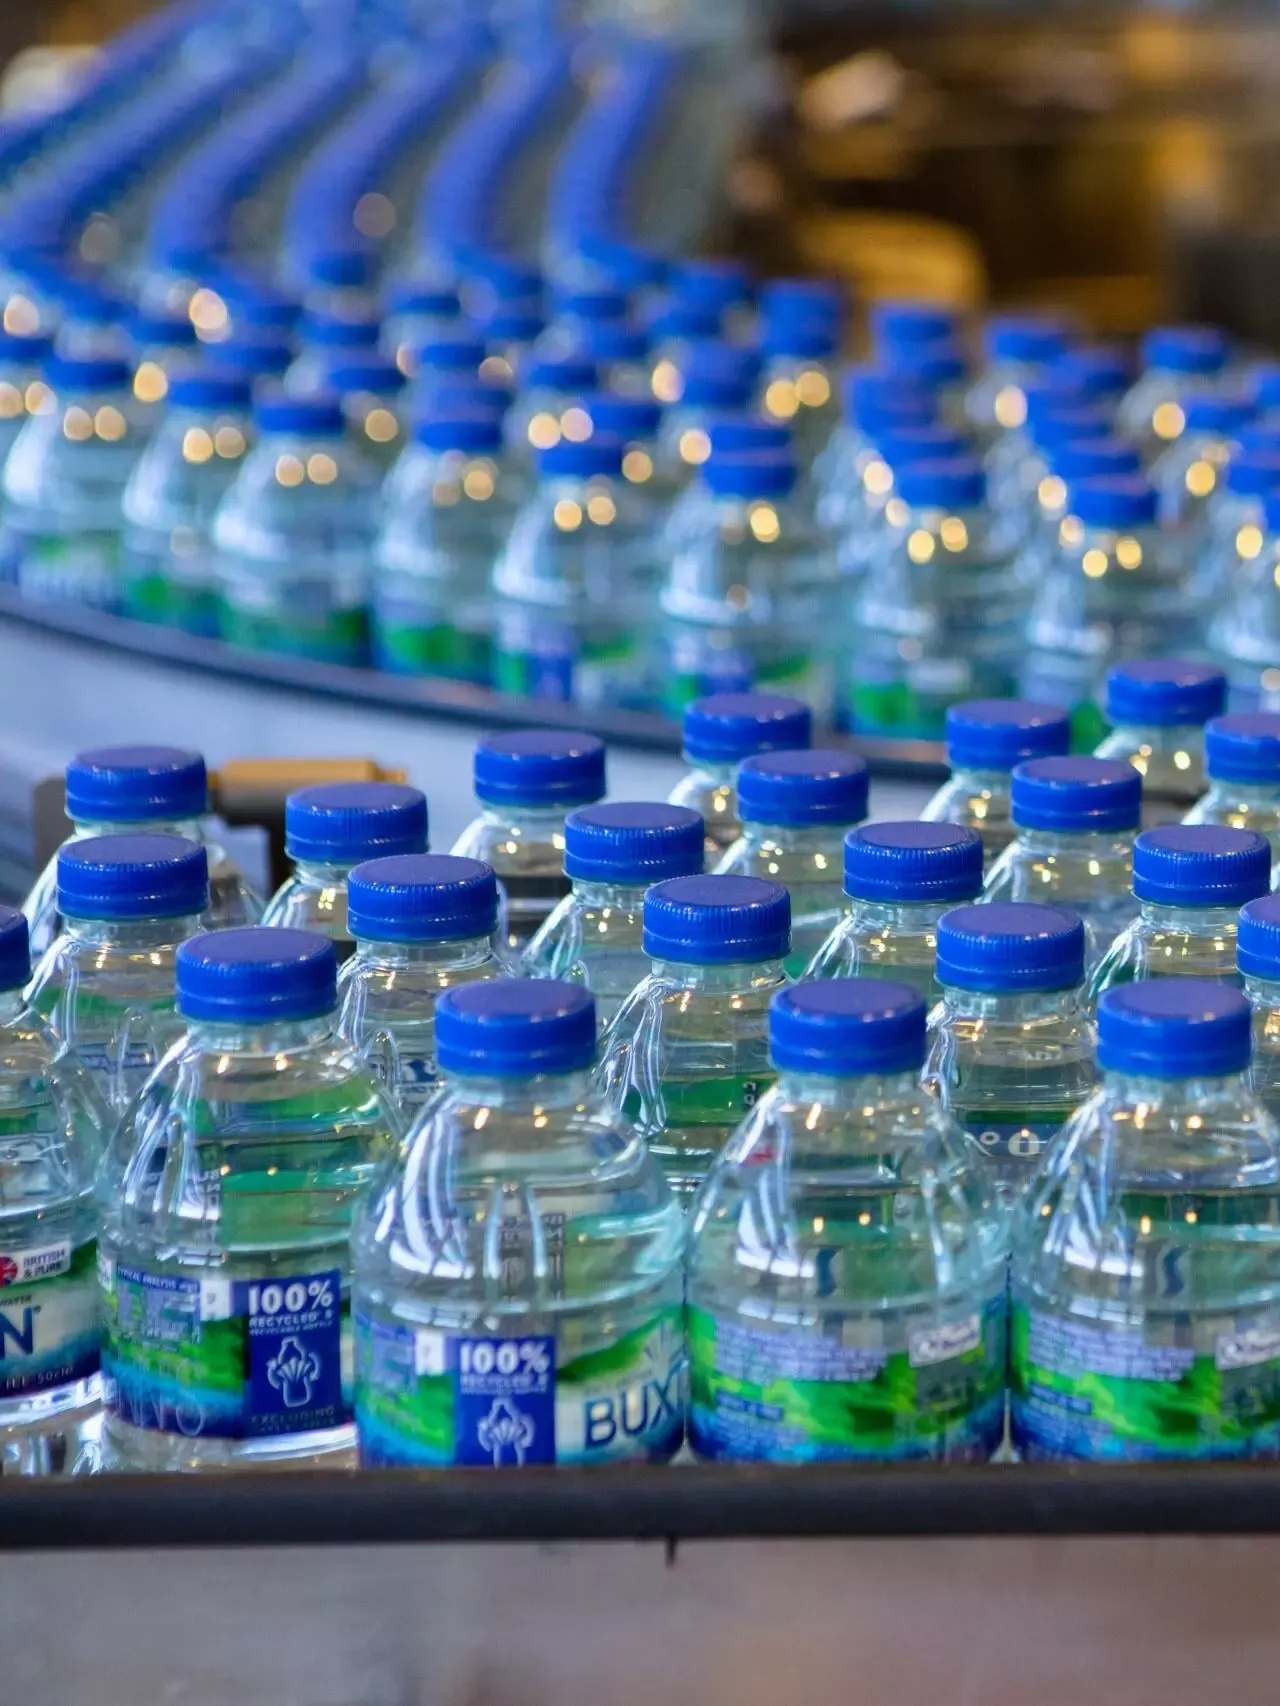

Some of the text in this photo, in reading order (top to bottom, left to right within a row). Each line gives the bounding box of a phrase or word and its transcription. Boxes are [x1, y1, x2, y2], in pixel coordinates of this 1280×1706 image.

[24, 1250, 66, 1267] BRITISH
[249, 1280, 333, 1316] 100%
[249, 1312, 318, 1328] RECYCLED
[461, 1342, 550, 1375] 100%
